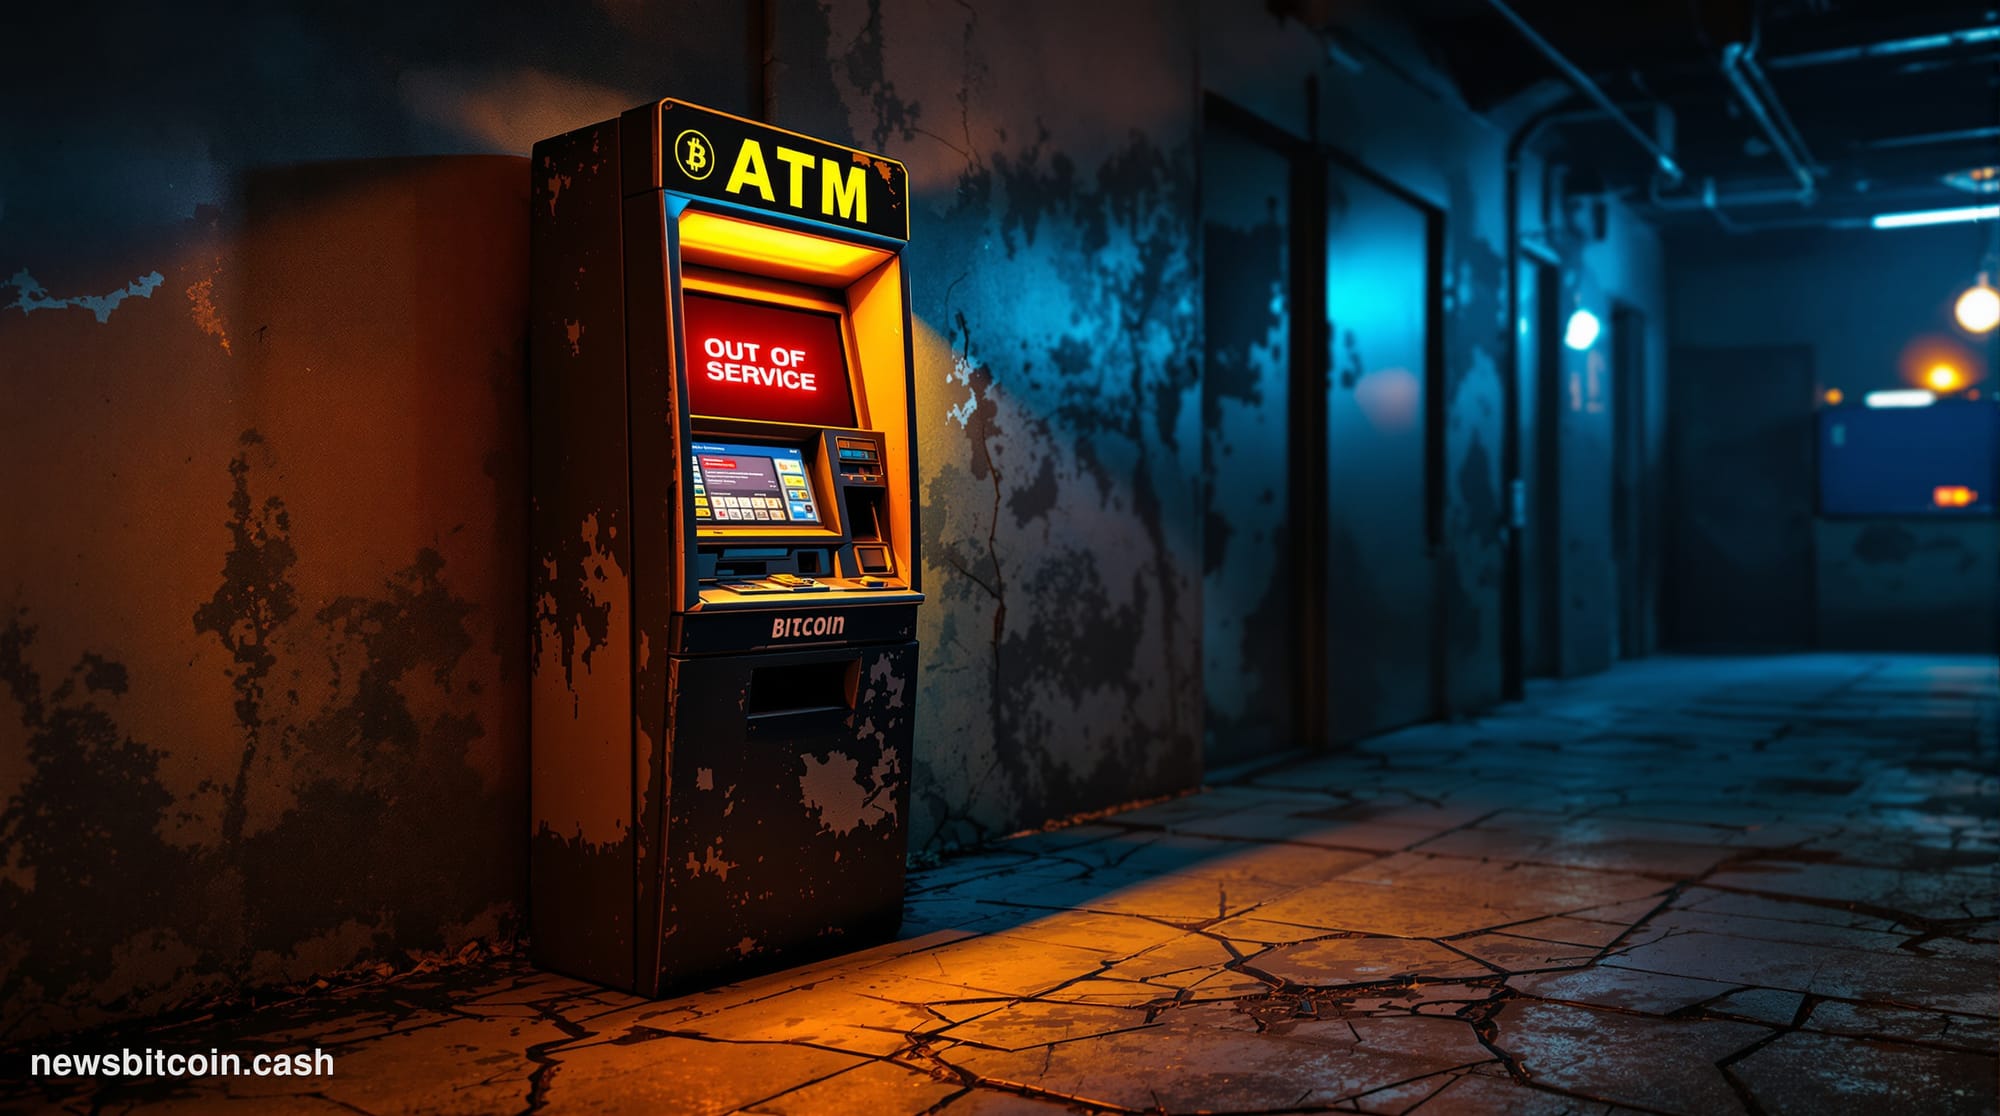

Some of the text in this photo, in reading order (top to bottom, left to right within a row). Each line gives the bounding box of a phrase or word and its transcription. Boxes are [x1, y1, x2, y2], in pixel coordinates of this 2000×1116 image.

[725, 138, 868, 224] ATM
[704, 338, 806, 368] OUT OF
[706, 361, 817, 391] SERVICE
